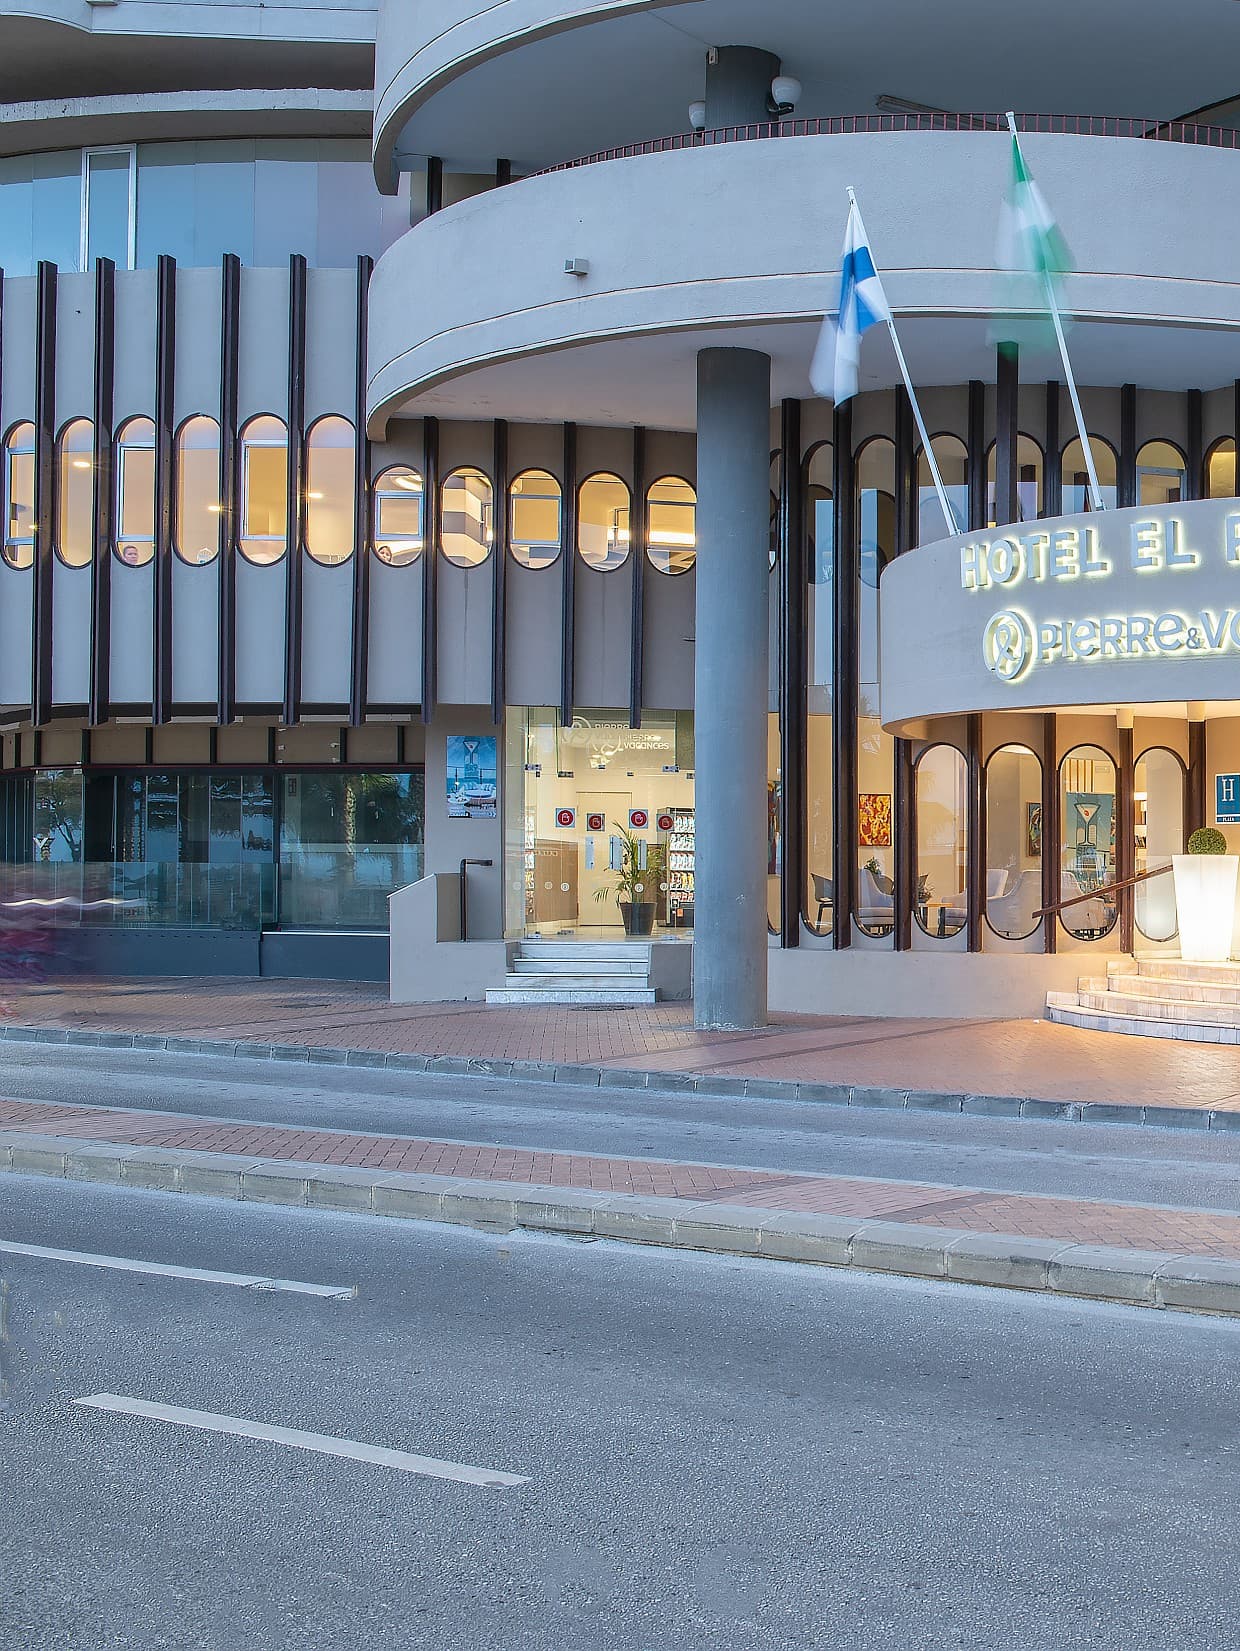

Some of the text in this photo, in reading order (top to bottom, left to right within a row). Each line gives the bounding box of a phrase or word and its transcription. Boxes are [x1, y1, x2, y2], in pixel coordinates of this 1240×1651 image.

[961, 530, 1107, 588] HOTEL
[1131, 520, 1196, 567] EL
[1221, 778, 1235, 802] H
